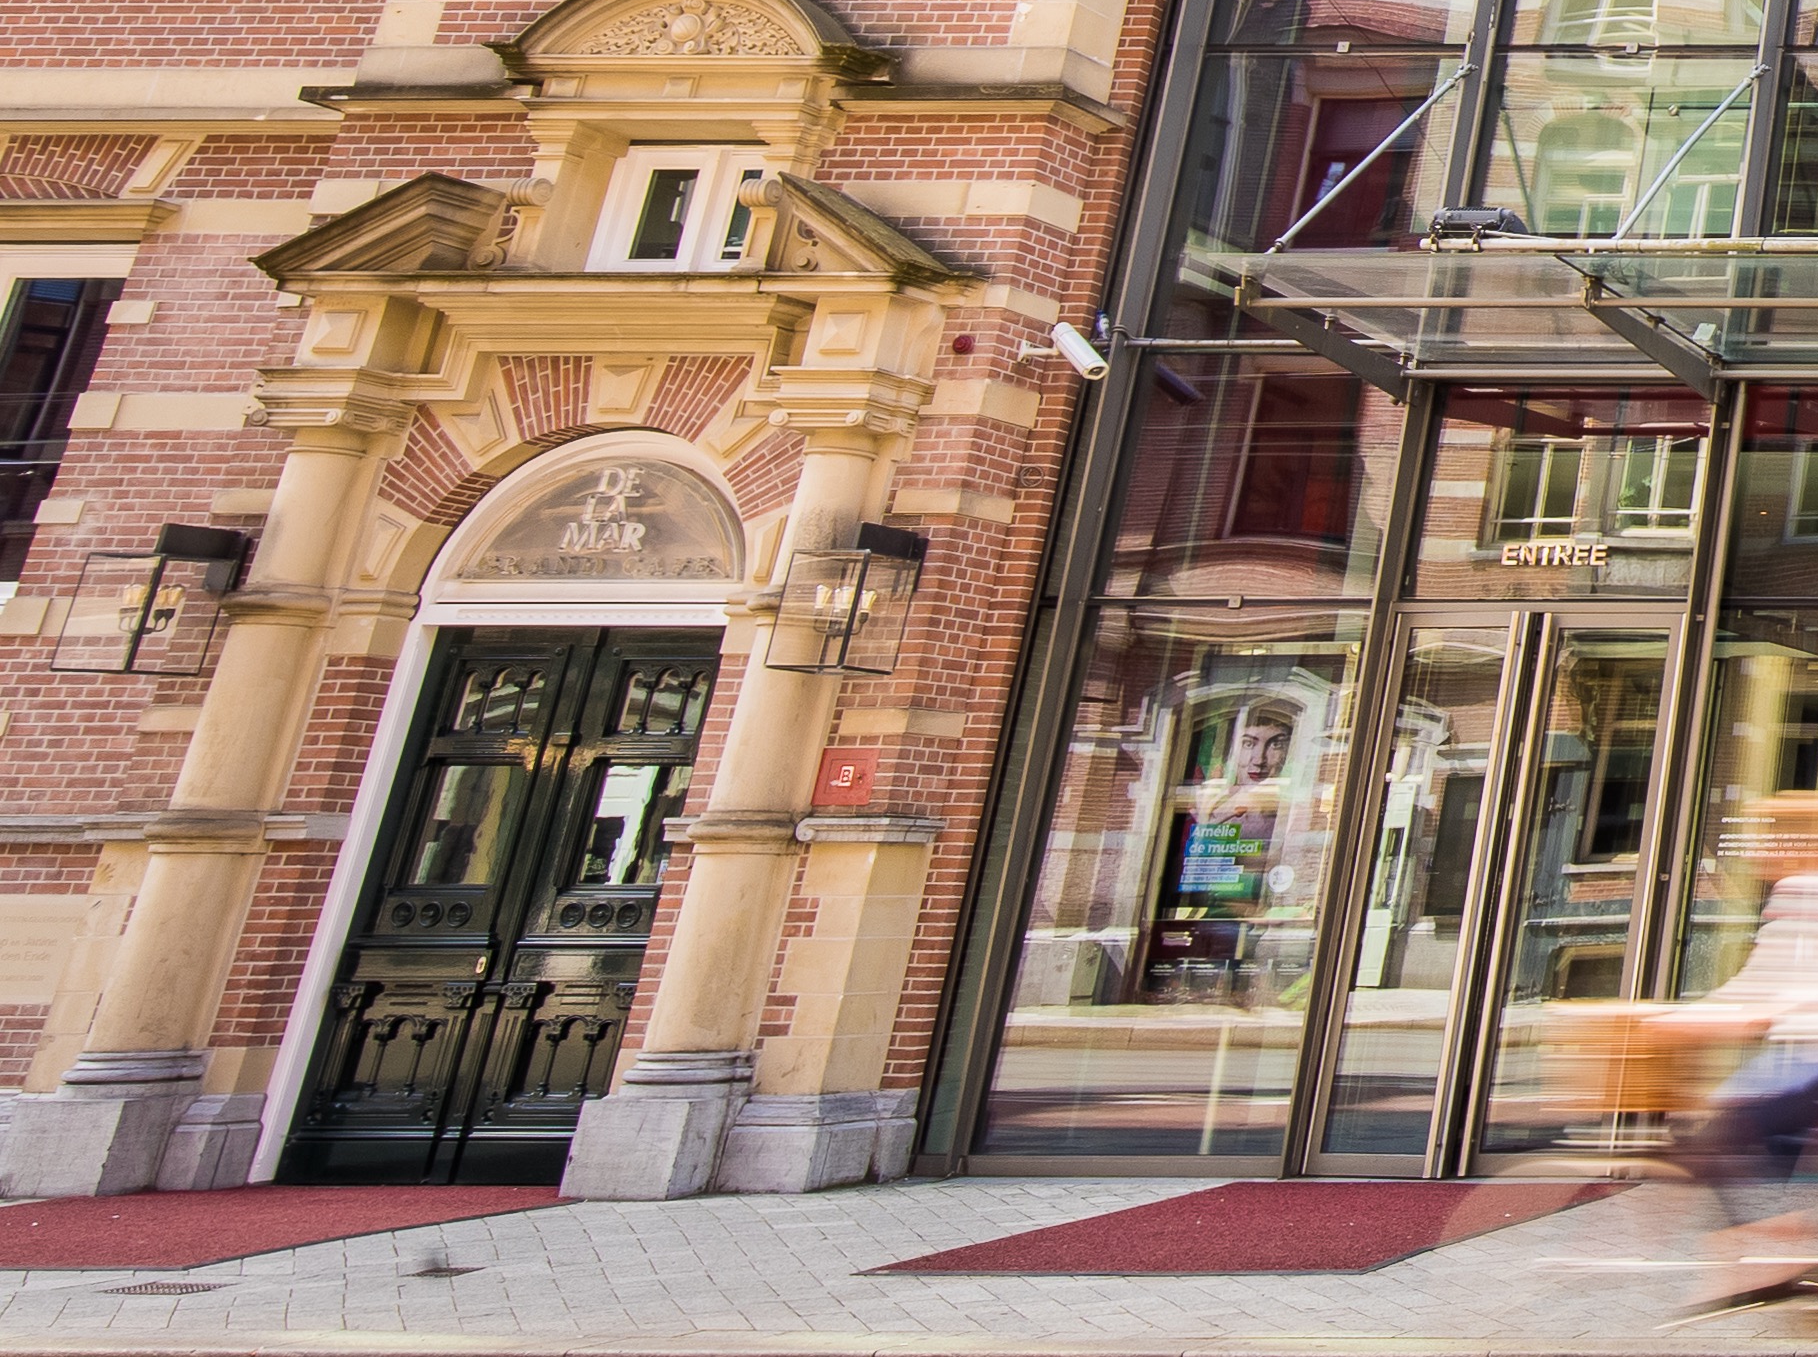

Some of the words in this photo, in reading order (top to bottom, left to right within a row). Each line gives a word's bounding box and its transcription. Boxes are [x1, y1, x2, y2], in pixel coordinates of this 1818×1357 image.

[599, 467, 646, 497] DE
[582, 494, 629, 524] LA
[558, 522, 646, 552] MAR
[1501, 544, 1608, 566] ENTREE
[1191, 824, 1237, 838] Amélie
[1189, 842, 1205, 853] de
[1208, 840, 1259, 854] musical
